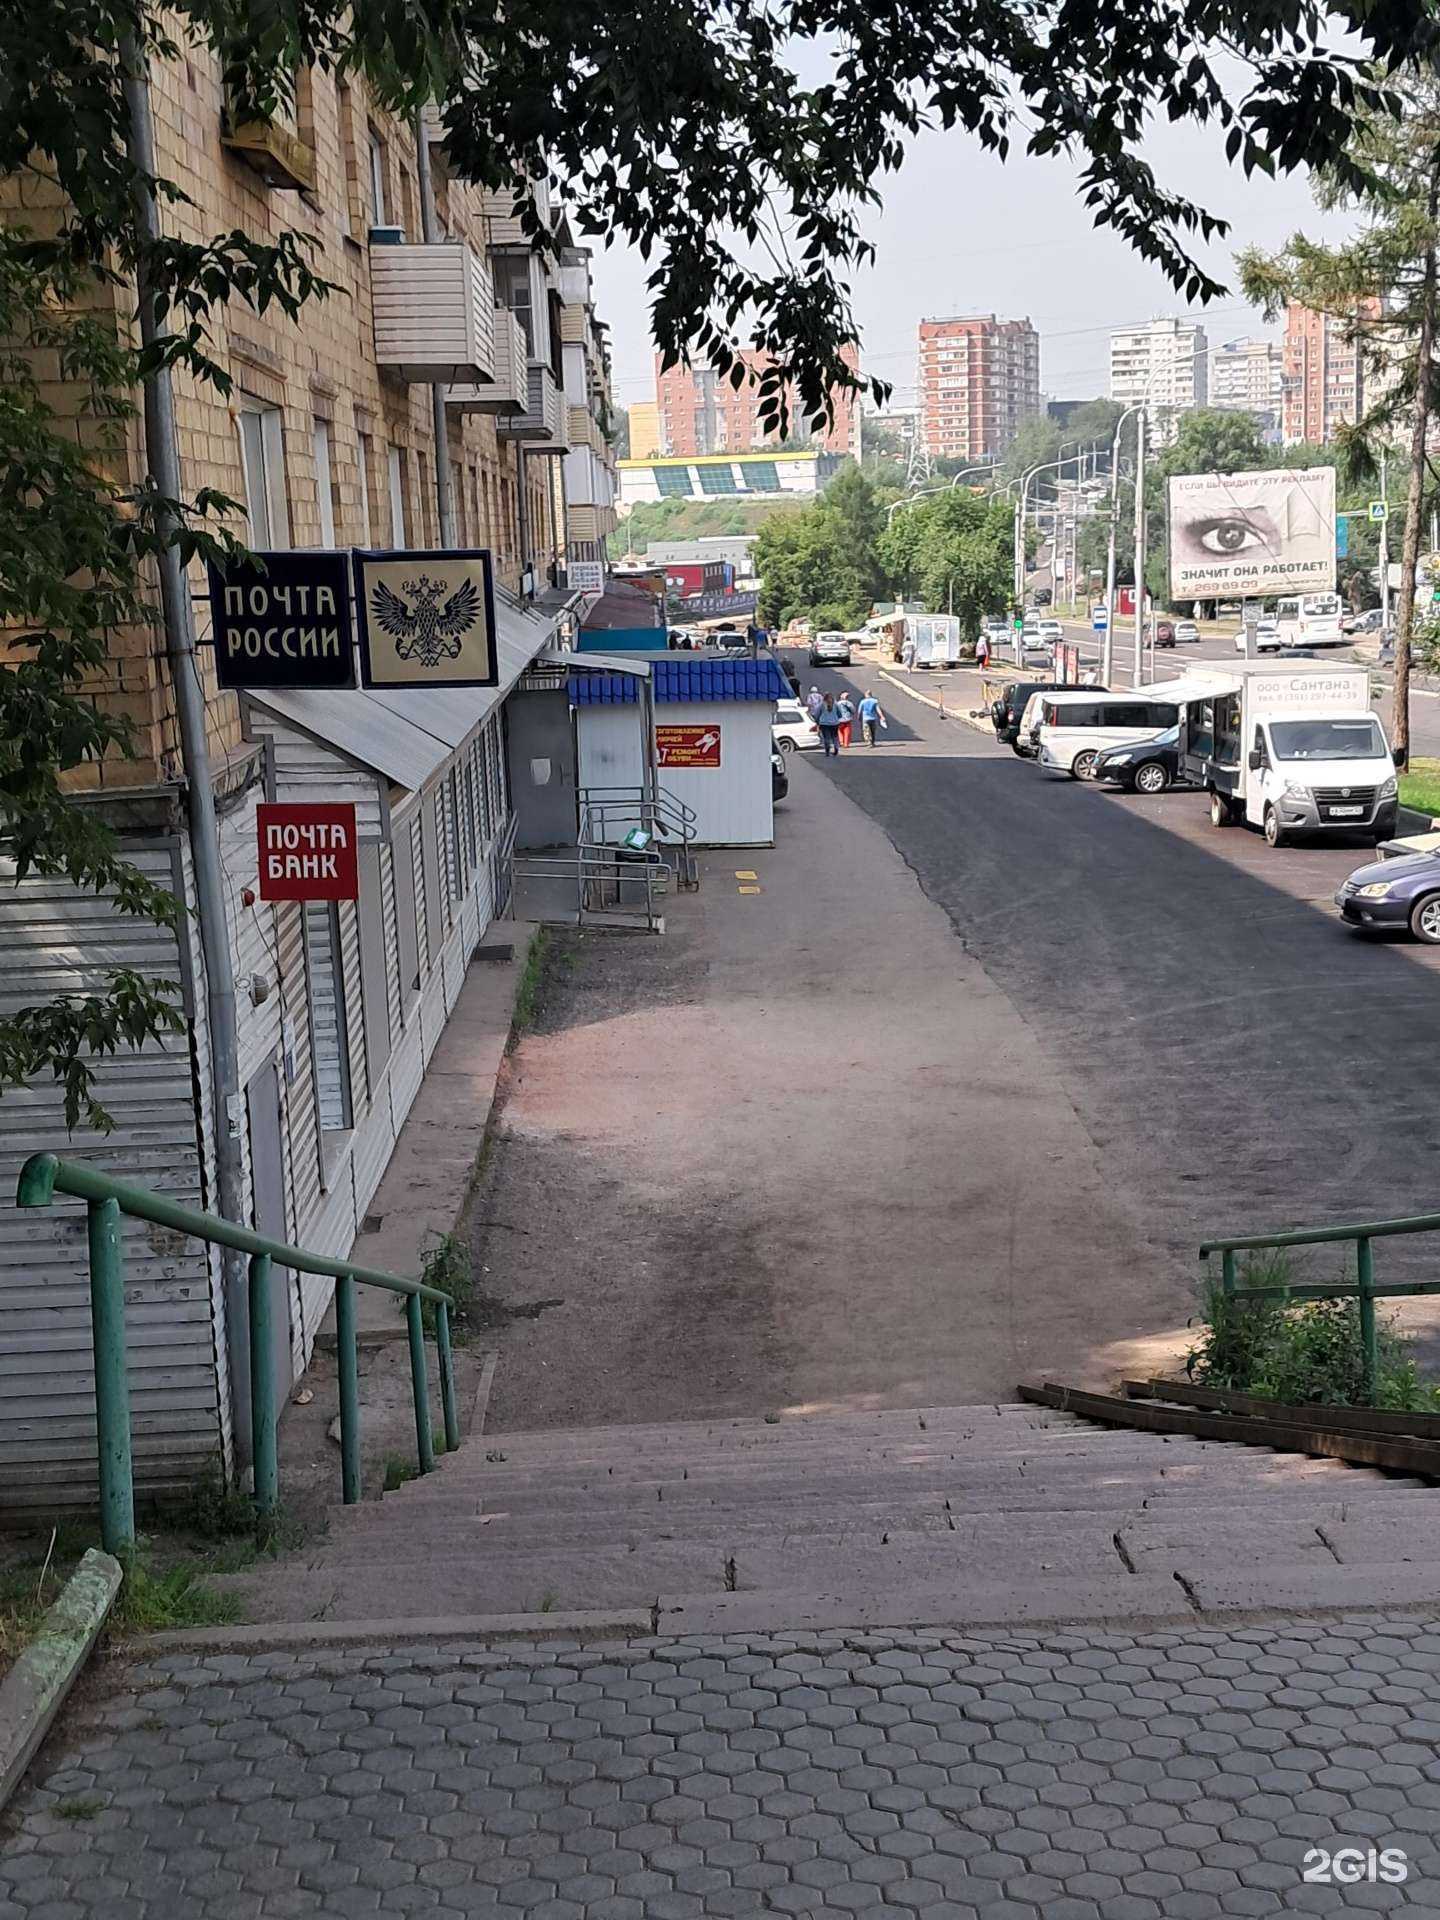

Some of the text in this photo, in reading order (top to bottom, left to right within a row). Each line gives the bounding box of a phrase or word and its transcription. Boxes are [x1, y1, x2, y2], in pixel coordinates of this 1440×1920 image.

[1181, 561, 1328, 580] ЗНАЧИТ ОНА РАБОТАЕТ!
[224, 585, 337, 616] ПОЧТА
[227, 626, 340, 658] РОССИИ
[266, 823, 347, 850] ПОЧТА
[268, 854, 340, 879] БАНК
